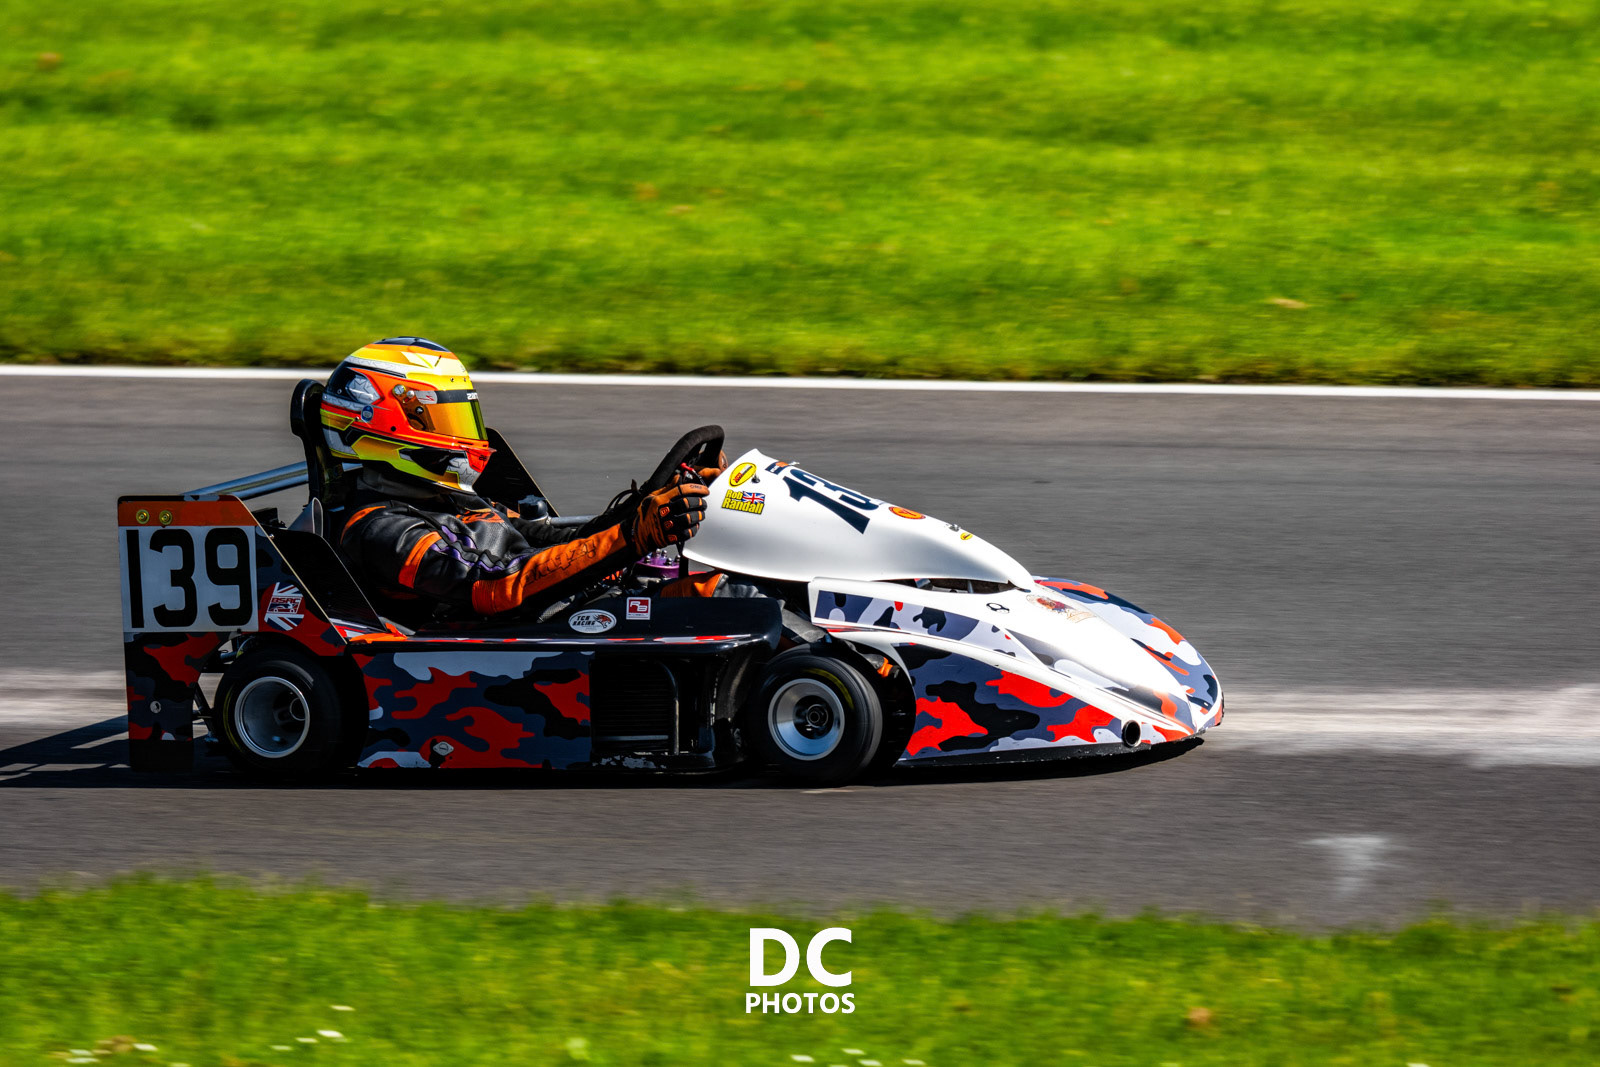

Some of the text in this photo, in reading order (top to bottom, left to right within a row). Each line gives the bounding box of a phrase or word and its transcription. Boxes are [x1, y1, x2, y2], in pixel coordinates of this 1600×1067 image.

[725, 489, 743, 500] Rob
[721, 497, 765, 515] Randall
[126, 527, 253, 628] 139
